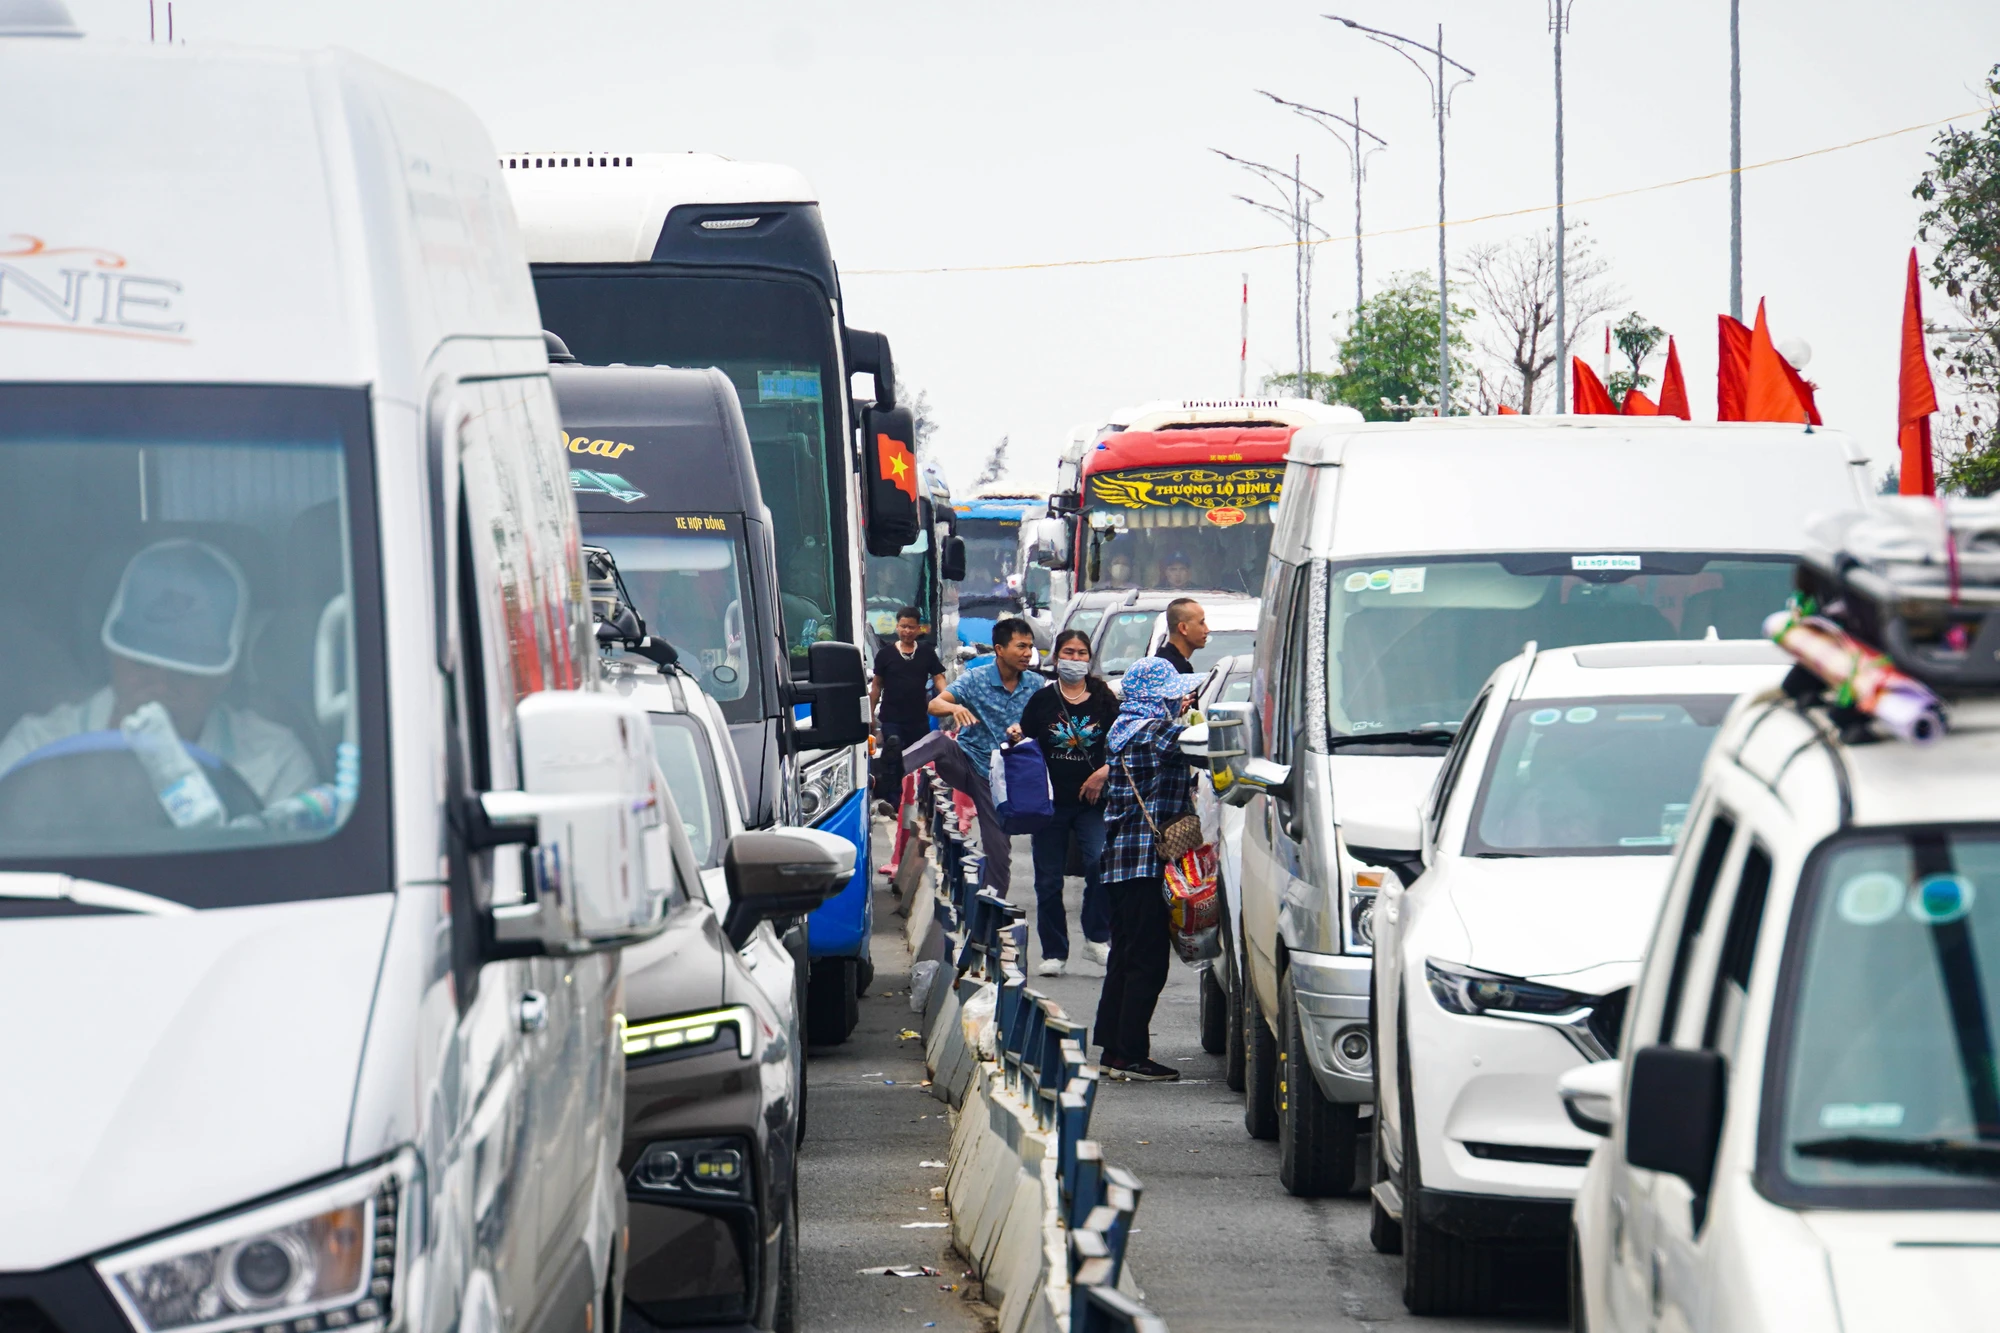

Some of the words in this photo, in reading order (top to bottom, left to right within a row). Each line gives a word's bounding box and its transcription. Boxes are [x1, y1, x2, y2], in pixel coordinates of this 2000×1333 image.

[1156, 484, 1213, 497] THƯỢNG
[1217, 482, 1234, 496] LỘ
[1237, 482, 1271, 494] BÌNH
[675, 517, 687, 529] XE
[687, 516, 702, 531] HỢP
[703, 515, 726, 531] ĐỒNG
